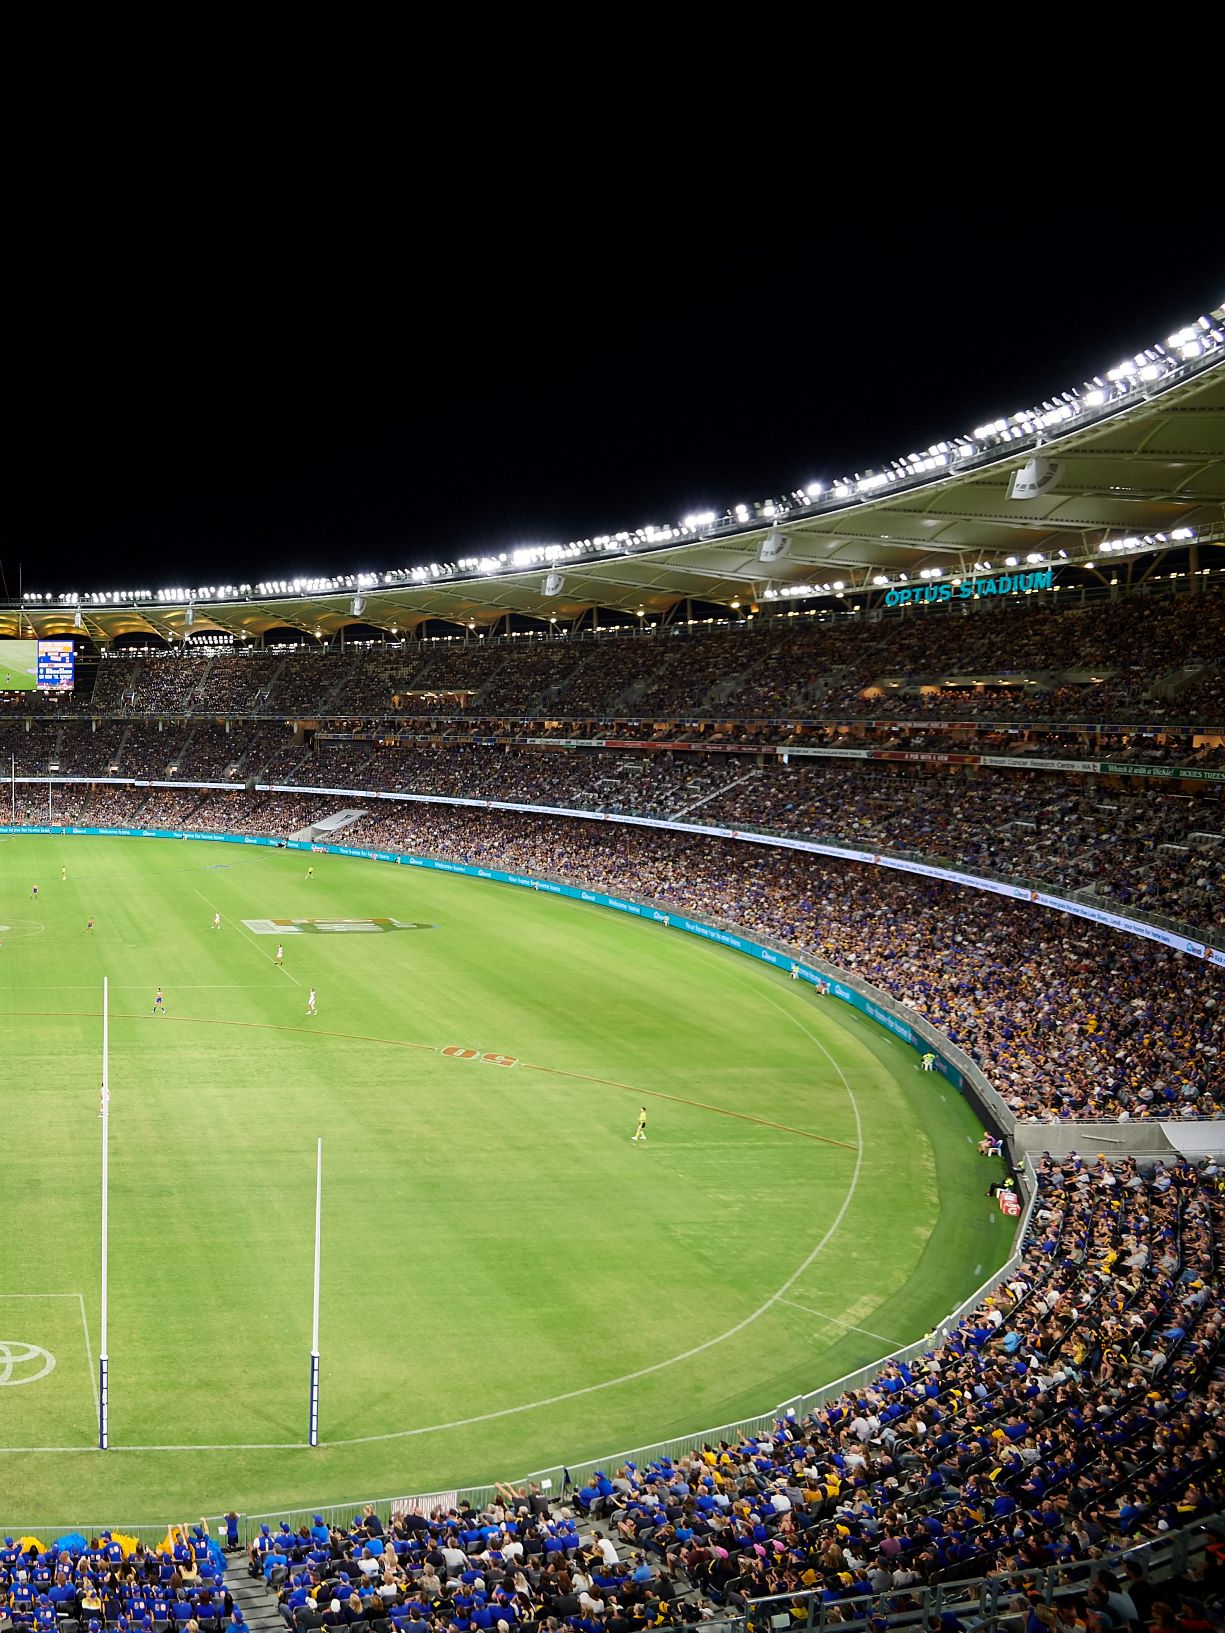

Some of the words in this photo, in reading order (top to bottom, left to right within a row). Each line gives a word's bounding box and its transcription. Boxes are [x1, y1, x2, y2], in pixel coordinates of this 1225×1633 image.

[885, 584, 952, 606] OPTUS
[959, 570, 1054, 598] STADIUM
[695, 924, 709, 935] home
[716, 932, 729, 942] home
[730, 936, 741, 947] loans
